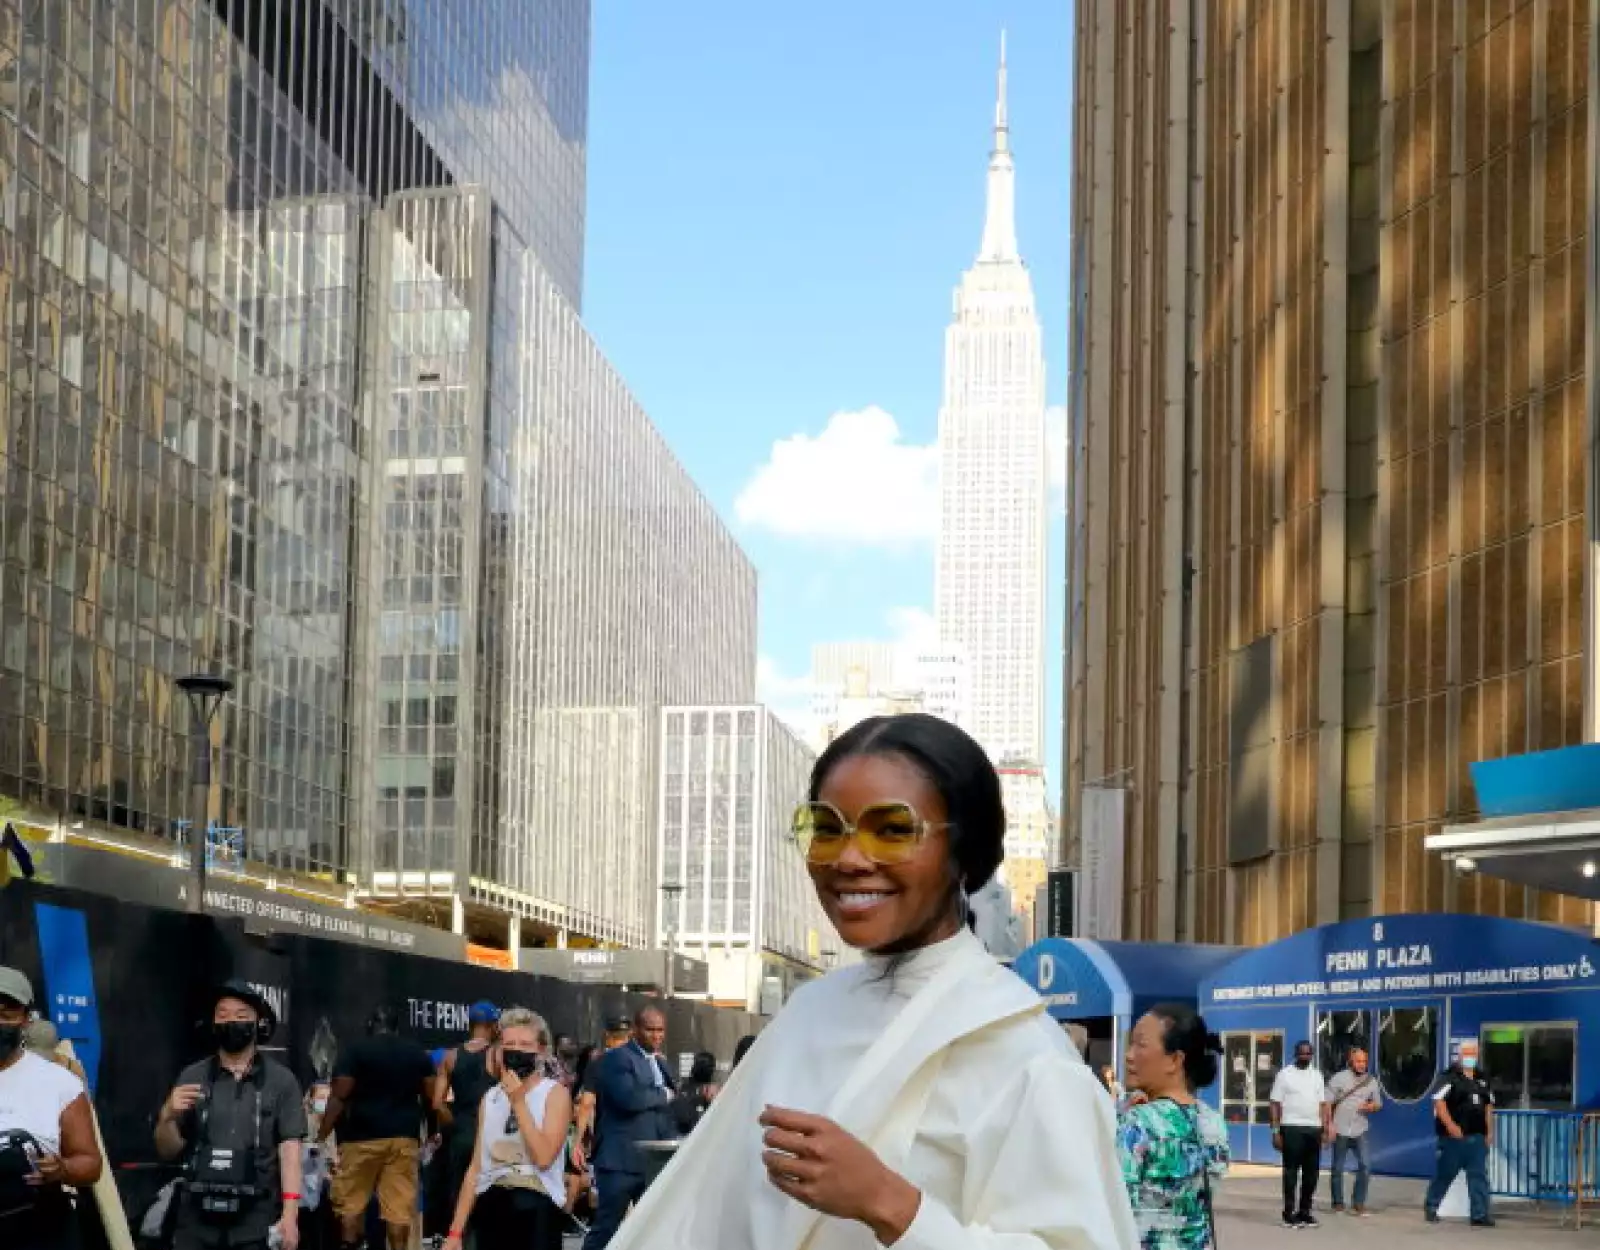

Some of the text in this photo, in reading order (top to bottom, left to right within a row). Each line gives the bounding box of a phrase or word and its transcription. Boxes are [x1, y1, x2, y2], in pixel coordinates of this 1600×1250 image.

[203, 889, 254, 914] NNECTED
[1325, 944, 1432, 973] PENN PLAZA
[1433, 972, 1462, 988] WITH
[1465, 966, 1540, 985] DISABILITIES
[1543, 964, 1577, 981] ONLY
[407, 998, 433, 1028] THE
